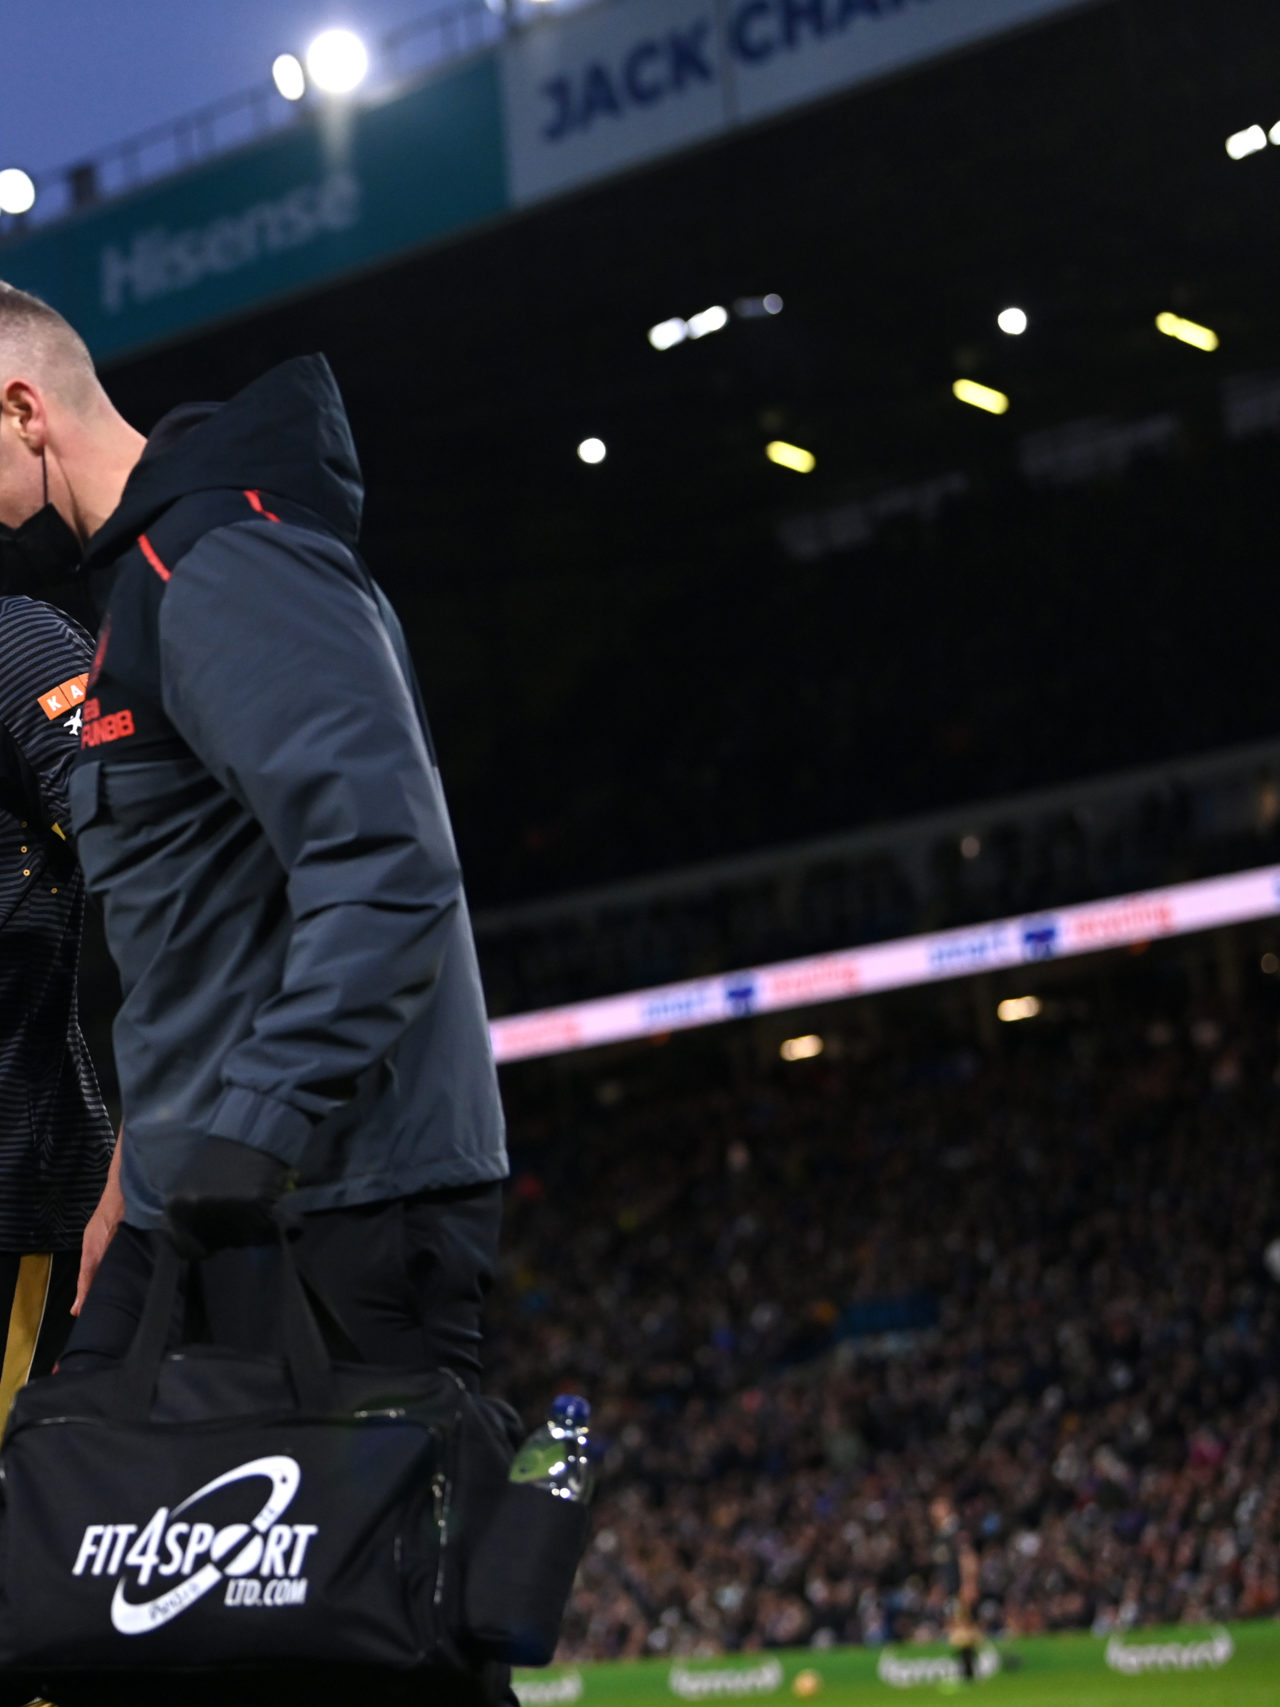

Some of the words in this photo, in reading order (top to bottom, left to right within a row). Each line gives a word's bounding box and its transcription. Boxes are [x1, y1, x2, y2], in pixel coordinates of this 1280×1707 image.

[541, 14, 715, 143] JACK
[46, 675, 89, 711] KA
[72, 1506, 319, 1586] FIT4SPORT
[224, 1577, 308, 1607] LTD.COM
